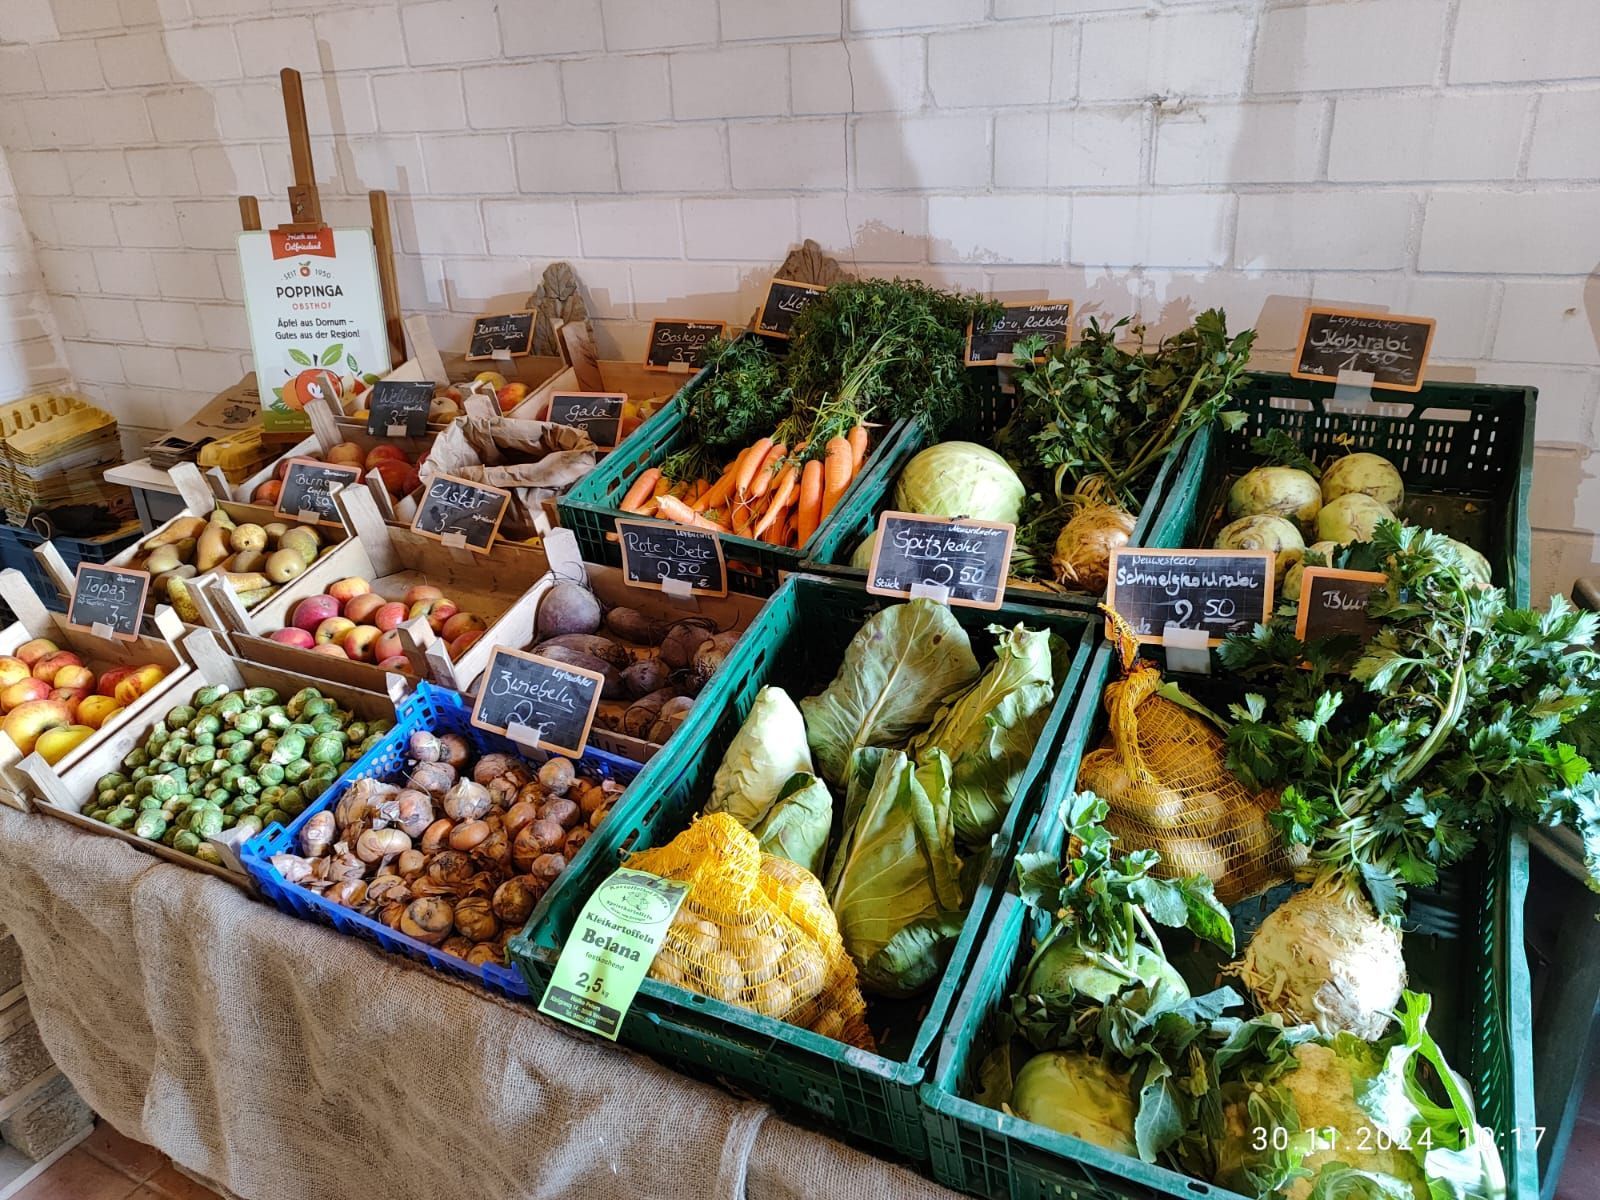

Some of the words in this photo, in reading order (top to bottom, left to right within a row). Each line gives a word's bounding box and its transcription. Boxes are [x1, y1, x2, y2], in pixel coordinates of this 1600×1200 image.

[276, 285, 343, 298] POPPINGA
[292, 302, 332, 311] OBSTHOF
[277, 317, 298, 329] Äpfel
[300, 319, 314, 327] aus
[275, 331, 298, 340] Gutes
[300, 331, 313, 339] aus
[315, 330, 329, 339] der
[330, 329, 361, 339] Region!
[657, 328, 706, 346] Boskop
[564, 404, 612, 423] Gala
[429, 483, 491, 509] Elstar
[623, 532, 664, 553] Rote
[666, 537, 716, 559] Bete
[892, 527, 987, 559] Spitzkohl
[85, 575, 127, 602] Topaz
[875, 576, 900, 590] Stück
[490, 669, 577, 710] Zwiebeln
[585, 911, 655, 945] Kleikartoffeln
[581, 927, 642, 963] Belana
[575, 972, 604, 994] 2,5
